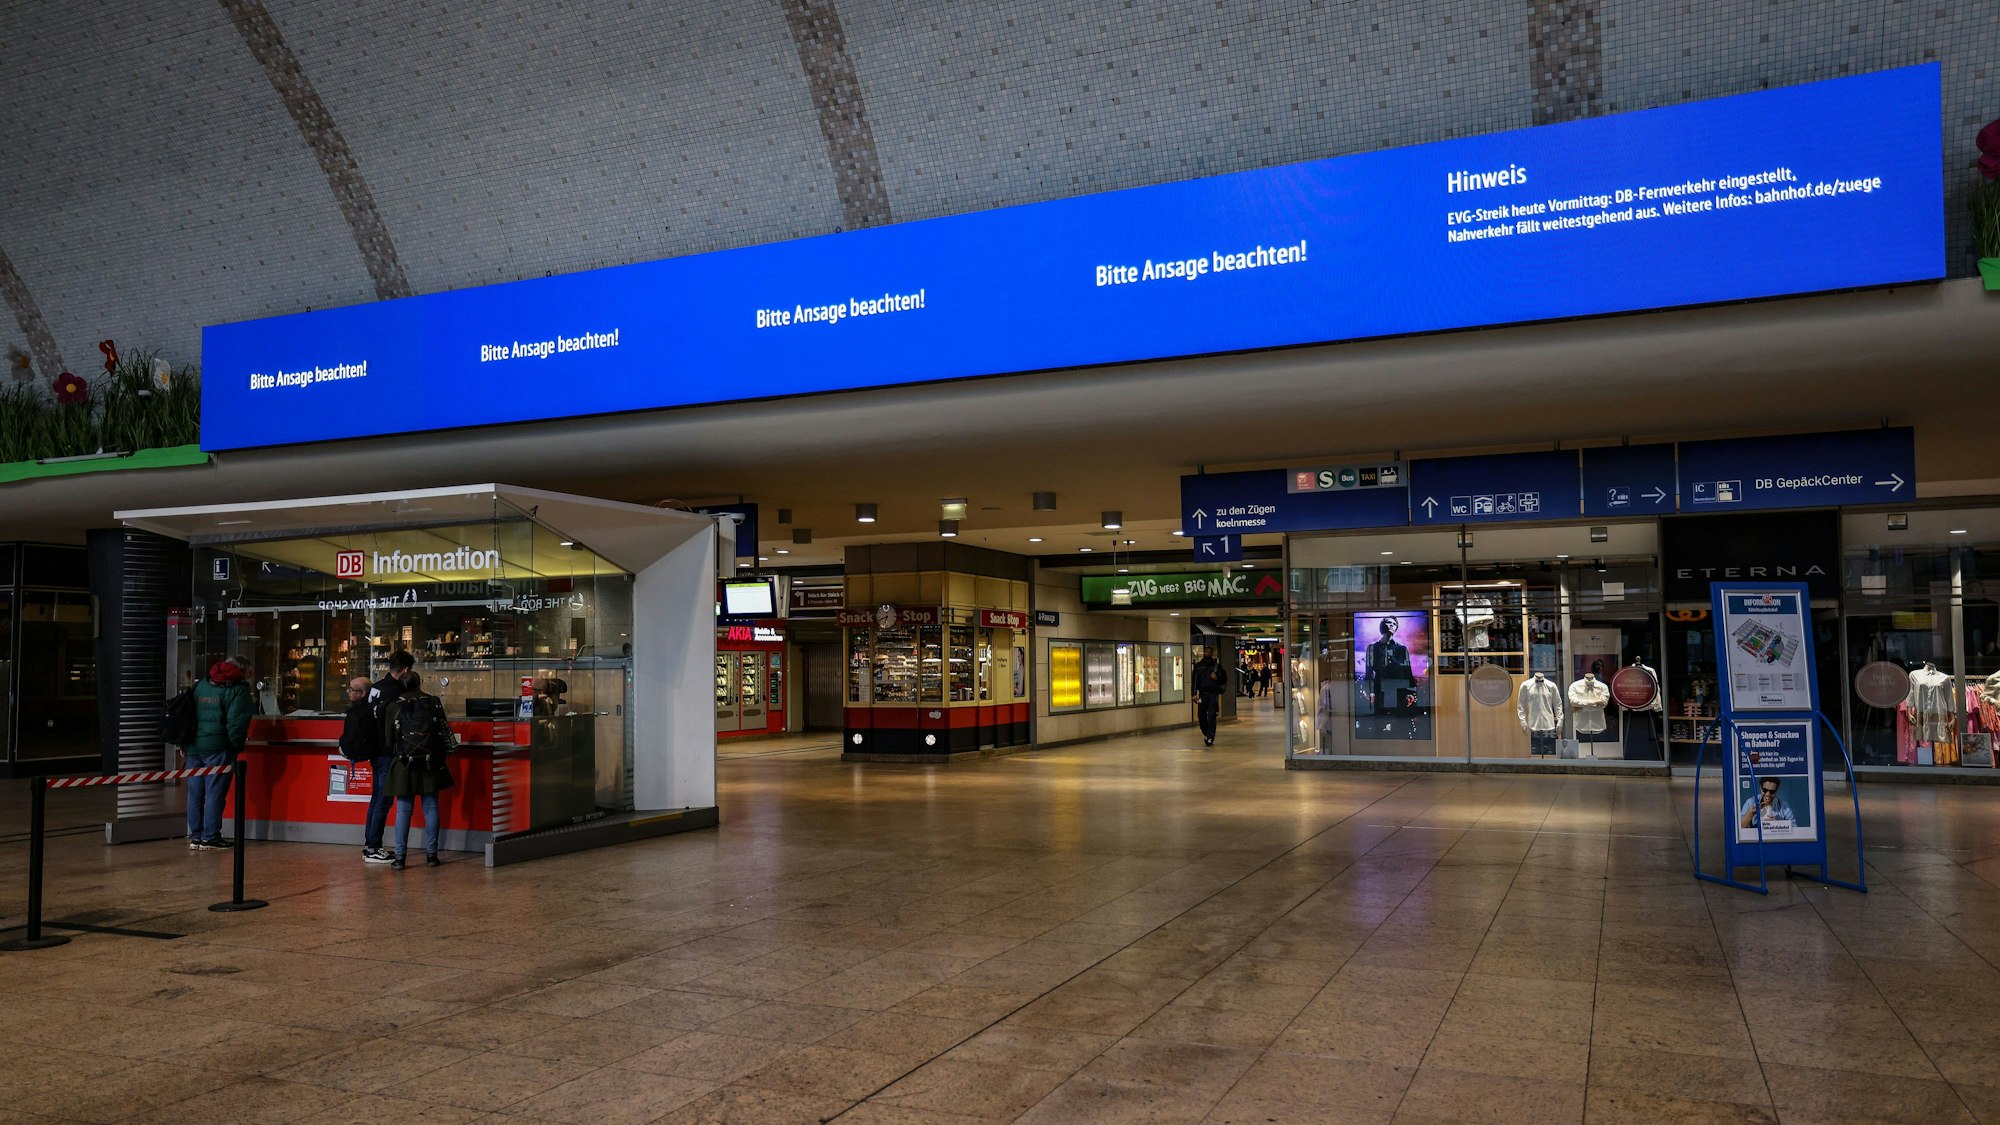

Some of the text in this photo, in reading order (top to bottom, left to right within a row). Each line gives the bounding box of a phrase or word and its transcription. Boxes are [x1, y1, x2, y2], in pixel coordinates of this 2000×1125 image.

[1448, 163, 1527, 194] Hinweis
[1447, 206, 1510, 225] EVG-Streik
[1511, 201, 1546, 217] heute
[1548, 195, 1613, 212] Vormittag:
[1615, 178, 1717, 203] DB-Fernverkehr
[1448, 177, 1881, 243] Nahverkehr fällt weitestgehend aus. Weitere Infos: bahnhof.de/zuege
[1096, 240, 1307, 287] Bitte Ansage beachten!
[756, 289, 925, 329] Bitte Ansage beachten!
[480, 328, 619, 362] Bitte Ansage beachten!
[250, 361, 367, 390] Bitte Ansage beachten!
[1319, 470, 1334, 488] S
[1341, 474, 1354, 483] Bus
[1360, 473, 1376, 481] TAXI
[1755, 474, 1863, 490] DB GepäckCenter
[1695, 484, 1705, 493] IC
[1216, 504, 1276, 517] zu den Zügen
[1452, 505, 1467, 514] WC
[1216, 518, 1266, 528] koelnmesse
[1220, 535, 1229, 554] 1
[339, 546, 499, 575] DB Information
[1677, 565, 1826, 579] ETERNA
[1127, 579, 1157, 598] ZUG
[1159, 583, 1180, 594] WEG?
[839, 609, 931, 624] Snack Stop
[989, 612, 1020, 627] Snack Stop
[1741, 731, 1800, 740] Shoppen & Snacken
[1751, 740, 1781, 748] Bahnhof?
